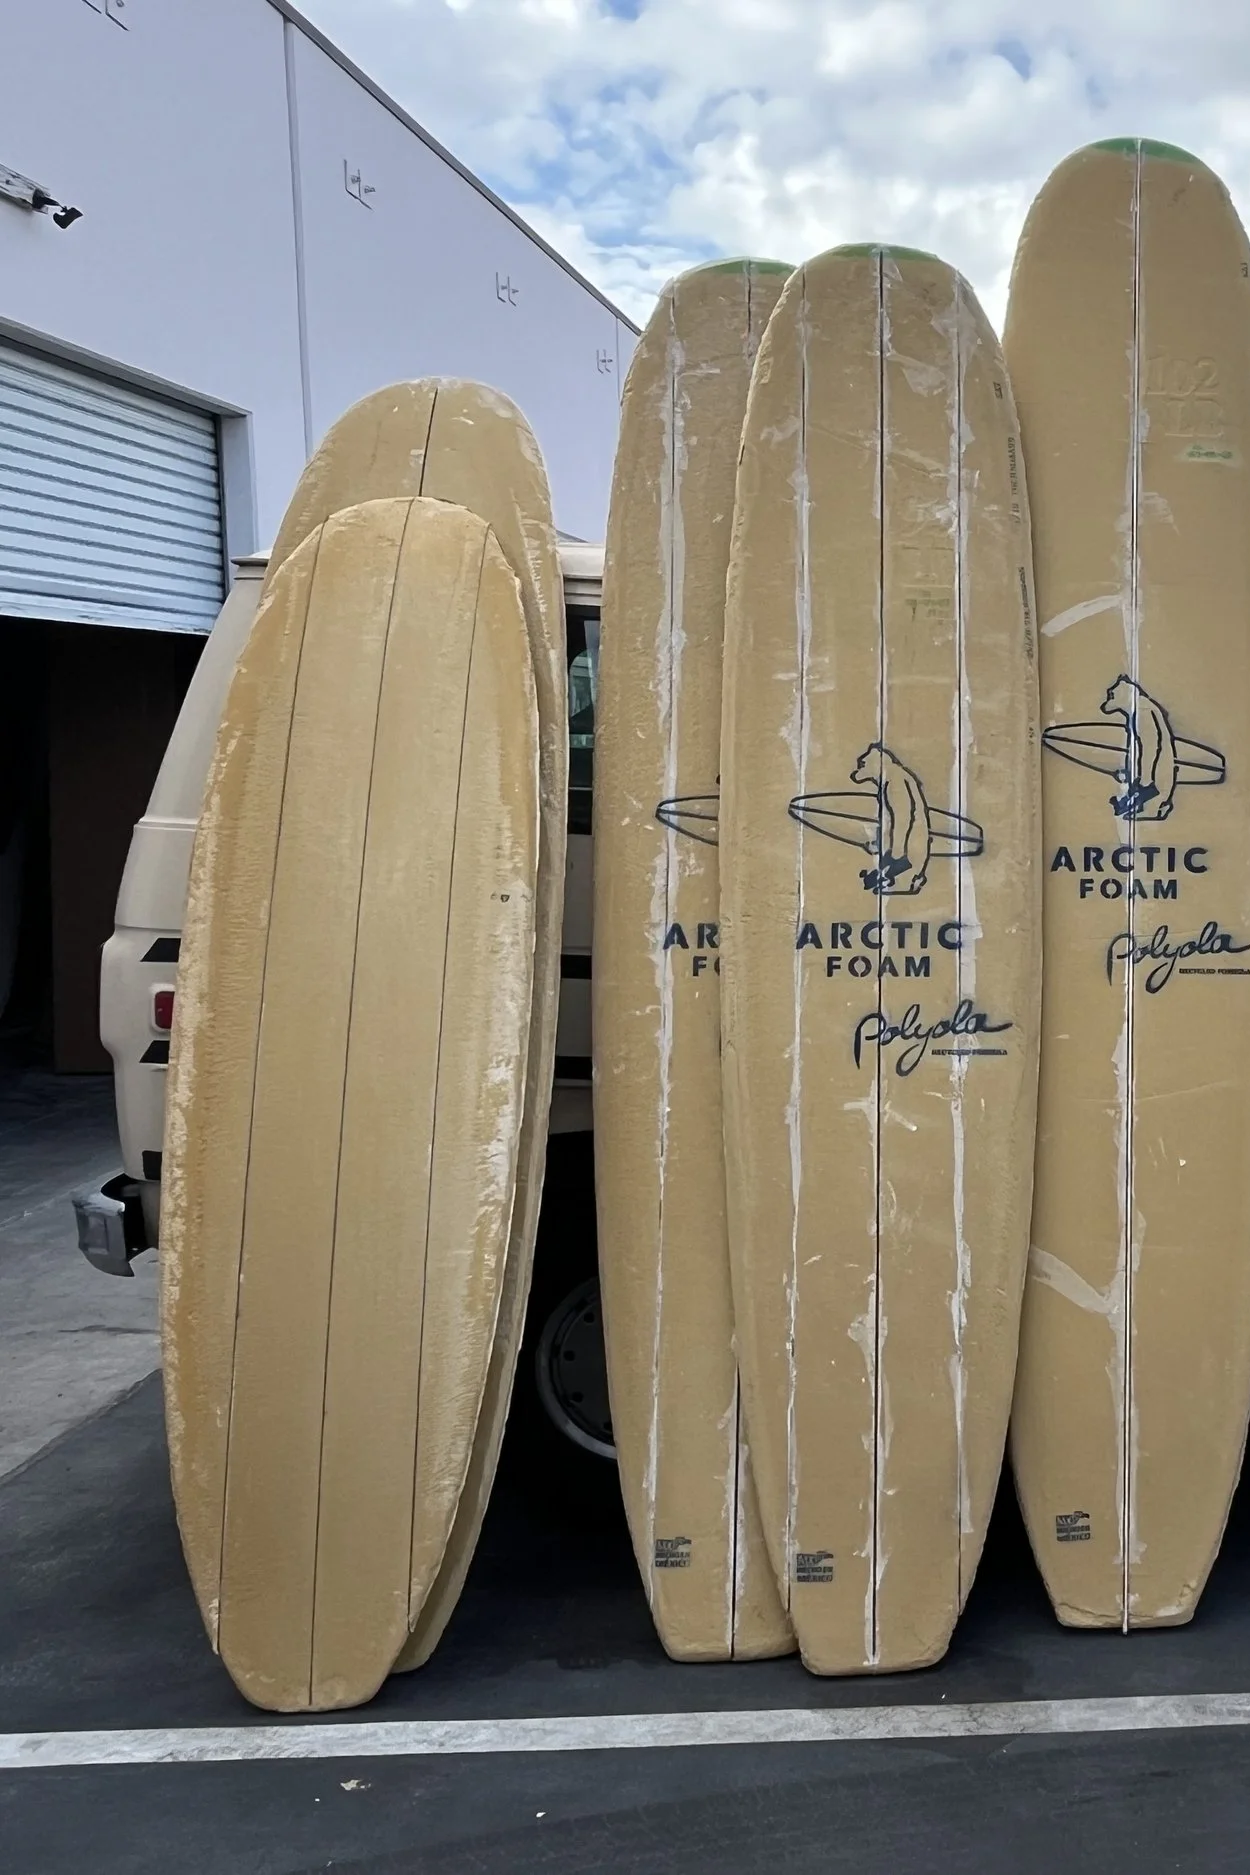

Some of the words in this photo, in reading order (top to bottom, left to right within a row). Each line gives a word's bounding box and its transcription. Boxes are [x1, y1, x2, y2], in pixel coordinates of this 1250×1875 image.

[1050, 845, 1209, 873] ARCTIC
[1079, 878, 1178, 900] FOAM
[796, 921, 962, 950] ARCTIC
[826, 955, 931, 978] FOAM
